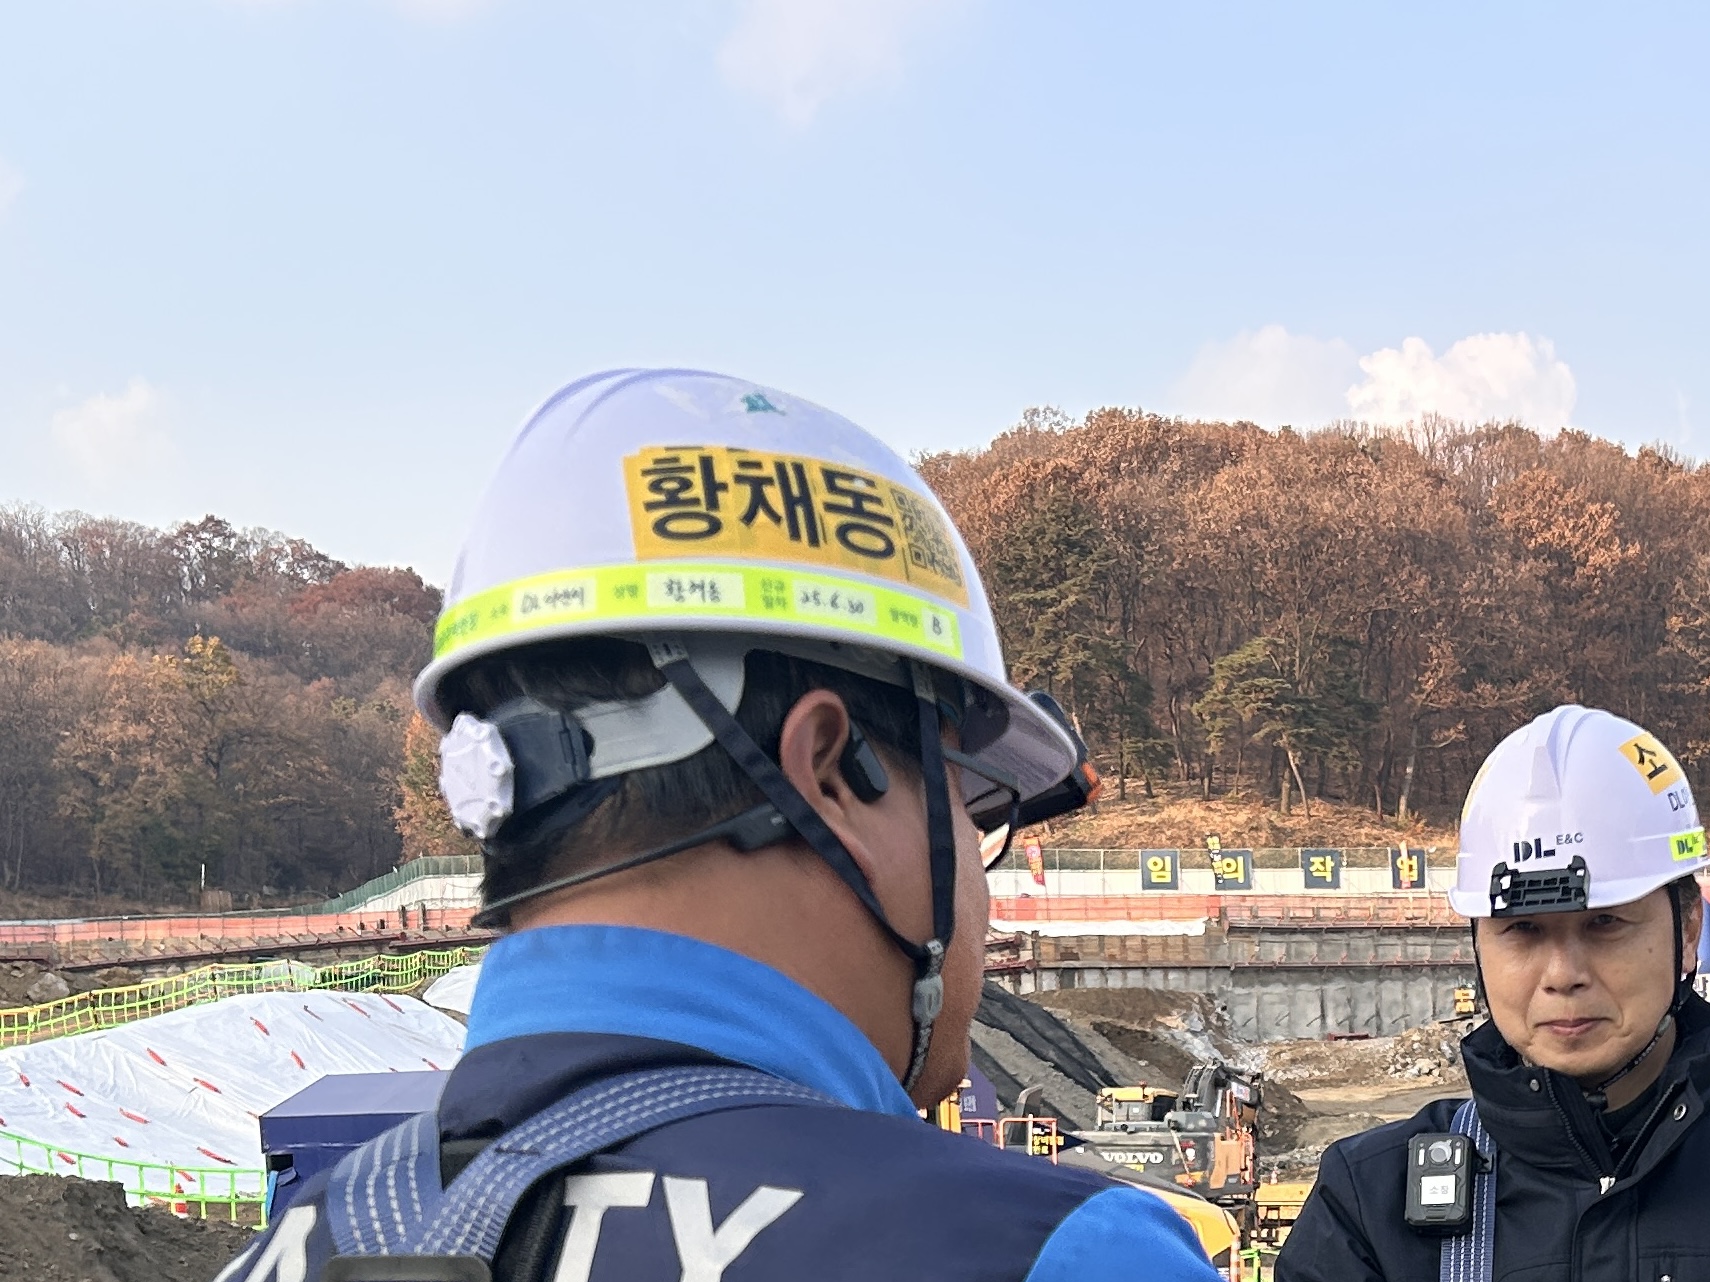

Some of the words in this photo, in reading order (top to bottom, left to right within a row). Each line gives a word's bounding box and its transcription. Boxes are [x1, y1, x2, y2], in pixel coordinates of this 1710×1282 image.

[641, 455, 895, 560] 황채동
[1513, 838, 1556, 863] DL
[1556, 832, 1584, 845] E&C
[1100, 1151, 1164, 1165] VOLVO
